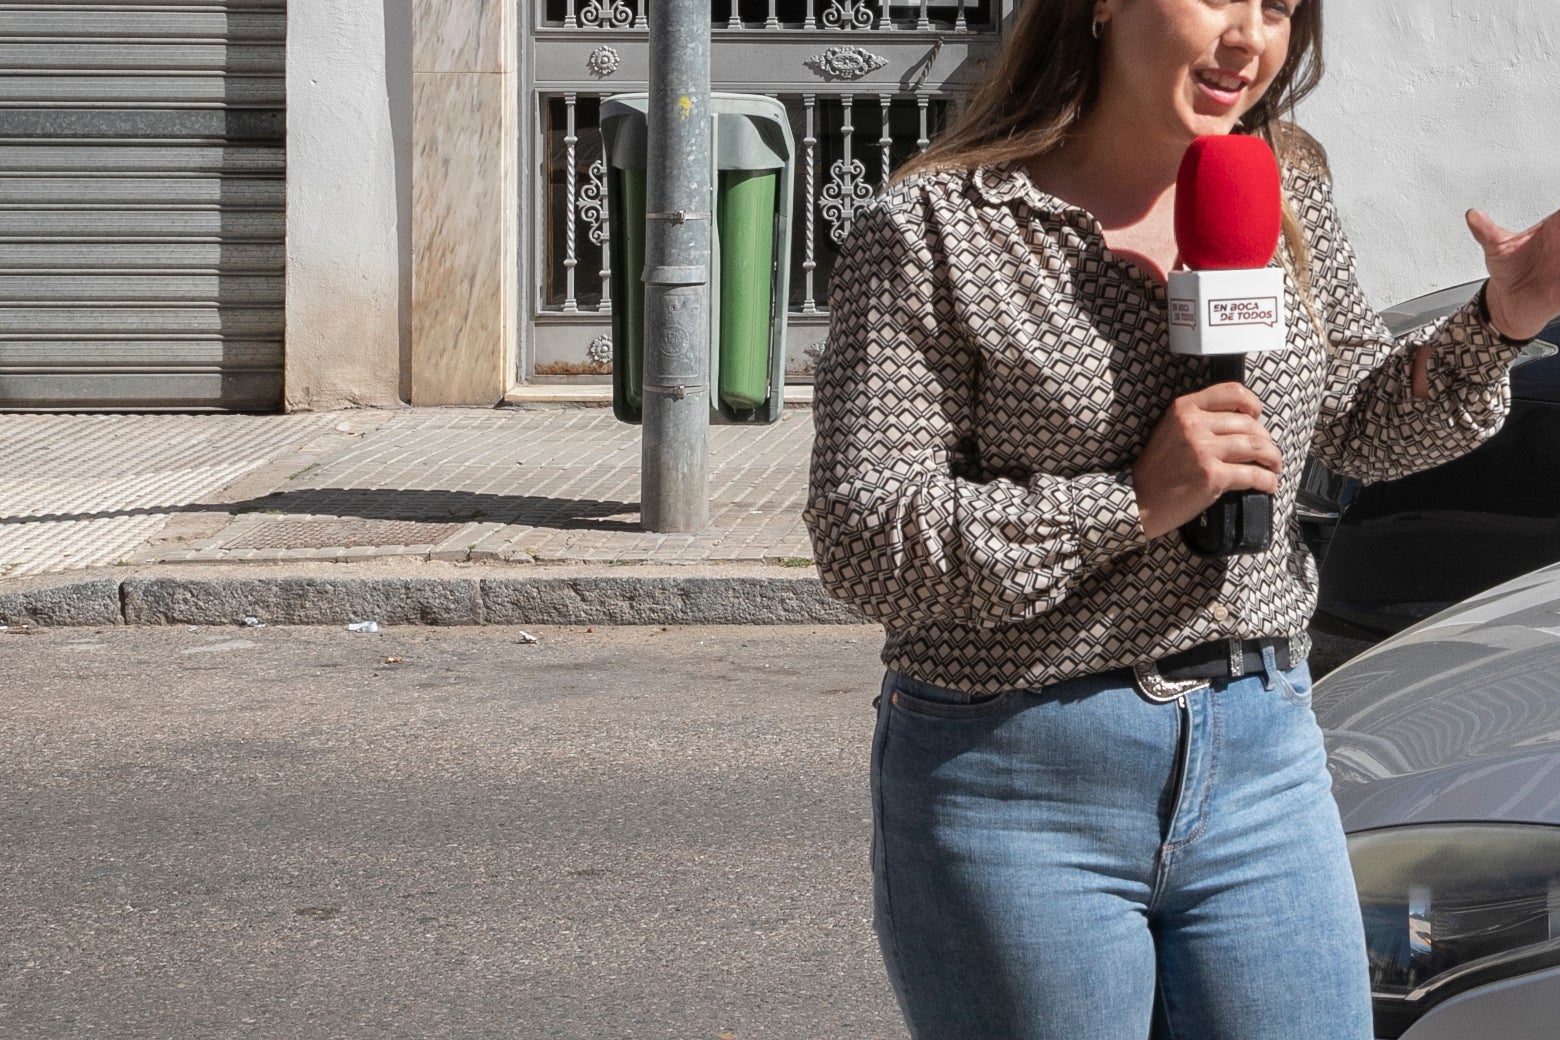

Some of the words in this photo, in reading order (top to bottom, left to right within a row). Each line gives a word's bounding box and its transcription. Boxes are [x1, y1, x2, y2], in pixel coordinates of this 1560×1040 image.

[1213, 303, 1228, 312] EN
[1230, 302, 1259, 312] BOCA
[1220, 312, 1234, 321] DE
[1237, 310, 1272, 320] TODOS
